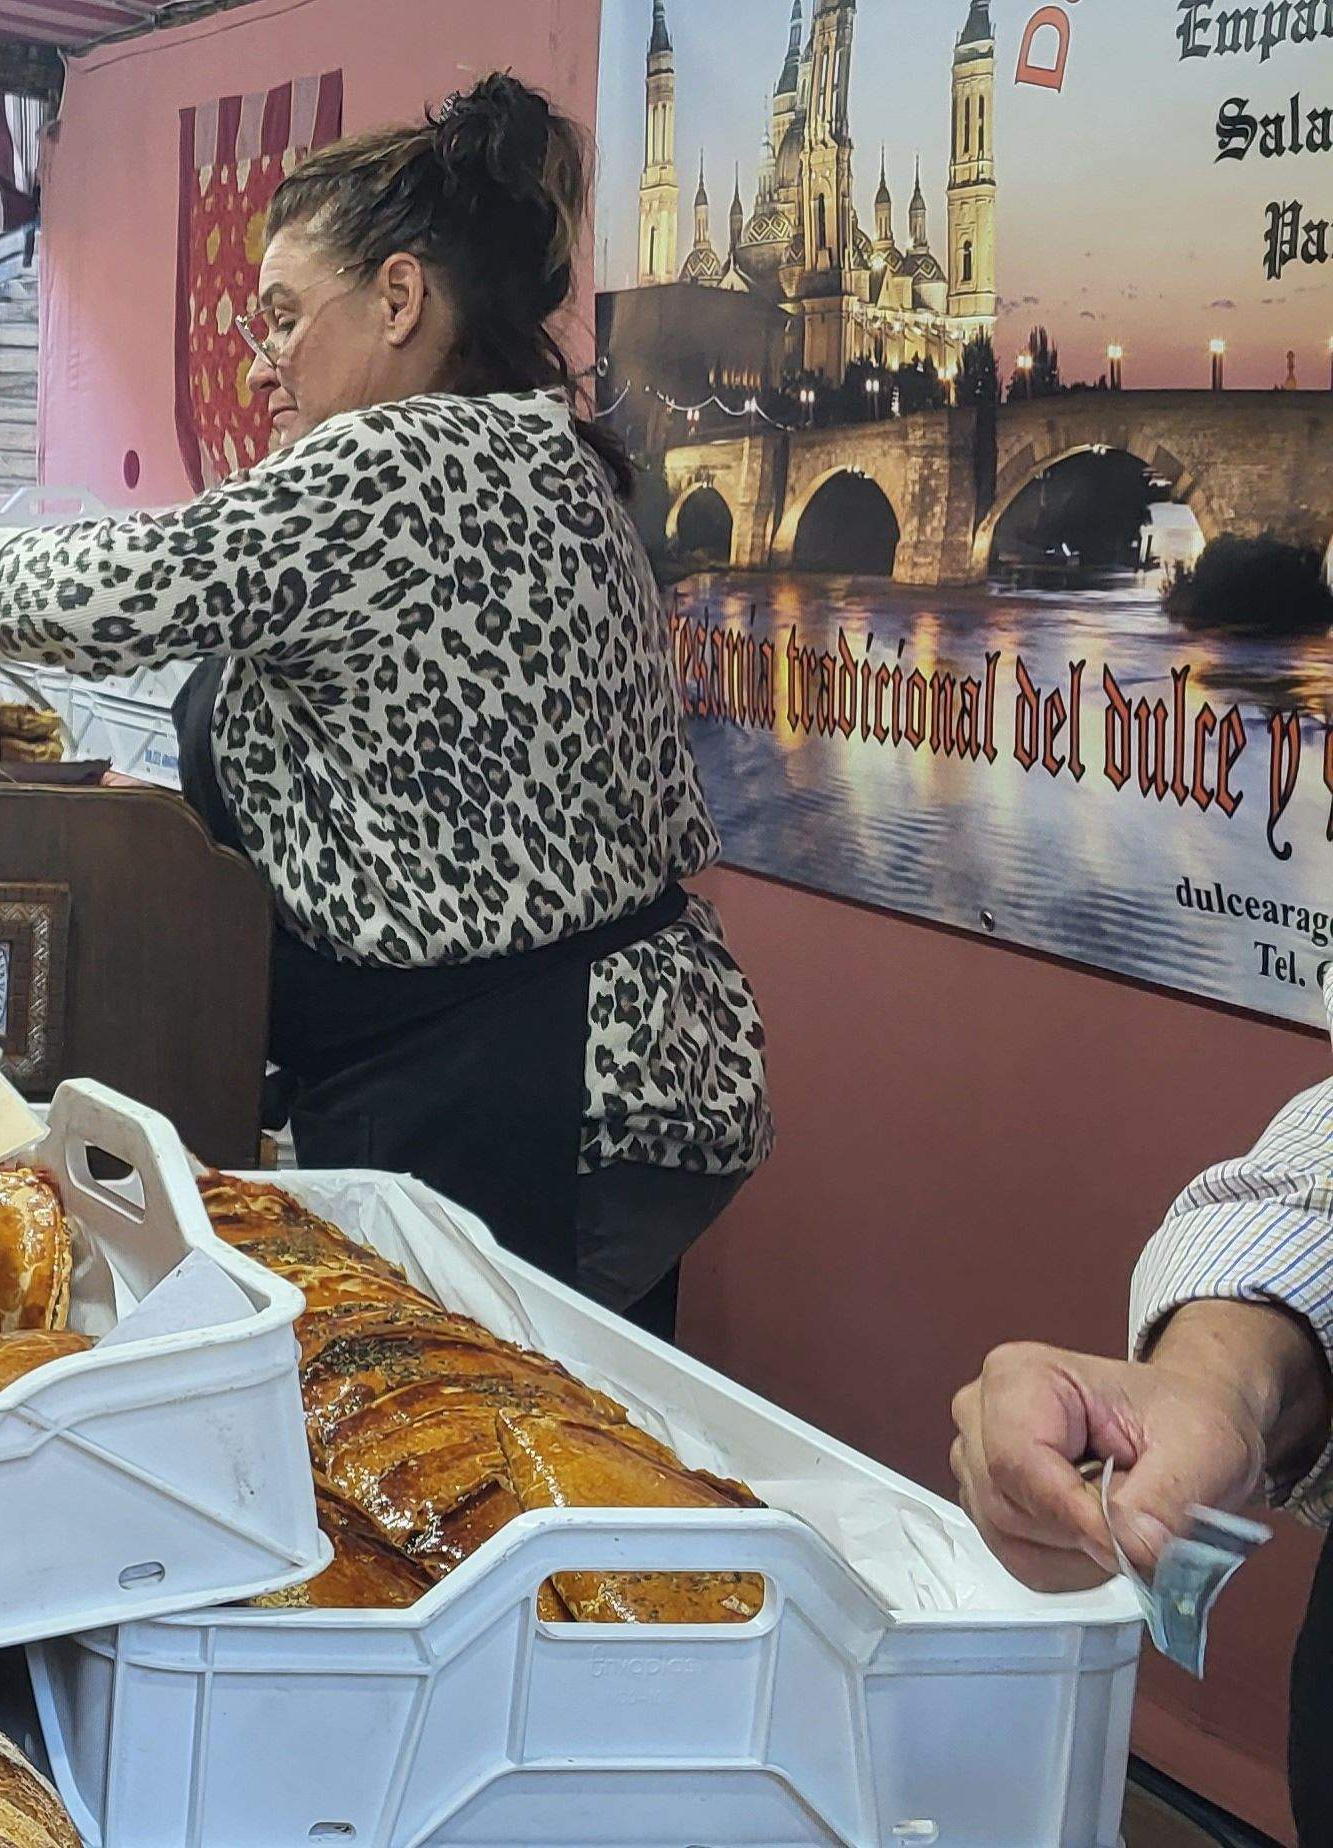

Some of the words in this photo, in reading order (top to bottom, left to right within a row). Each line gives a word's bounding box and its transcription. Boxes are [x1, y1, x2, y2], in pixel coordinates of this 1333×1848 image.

[1213, 91, 1333, 163] Sala
[1263, 199, 1333, 281] Pa
[787, 623, 1001, 765] tradicional
[1014, 655, 1086, 783] del
[1103, 663, 1247, 819] dulce
[1267, 709, 1302, 860] y
[1176, 877, 1333, 947] dulcearag
[1254, 942, 1306, 987] Tel.
